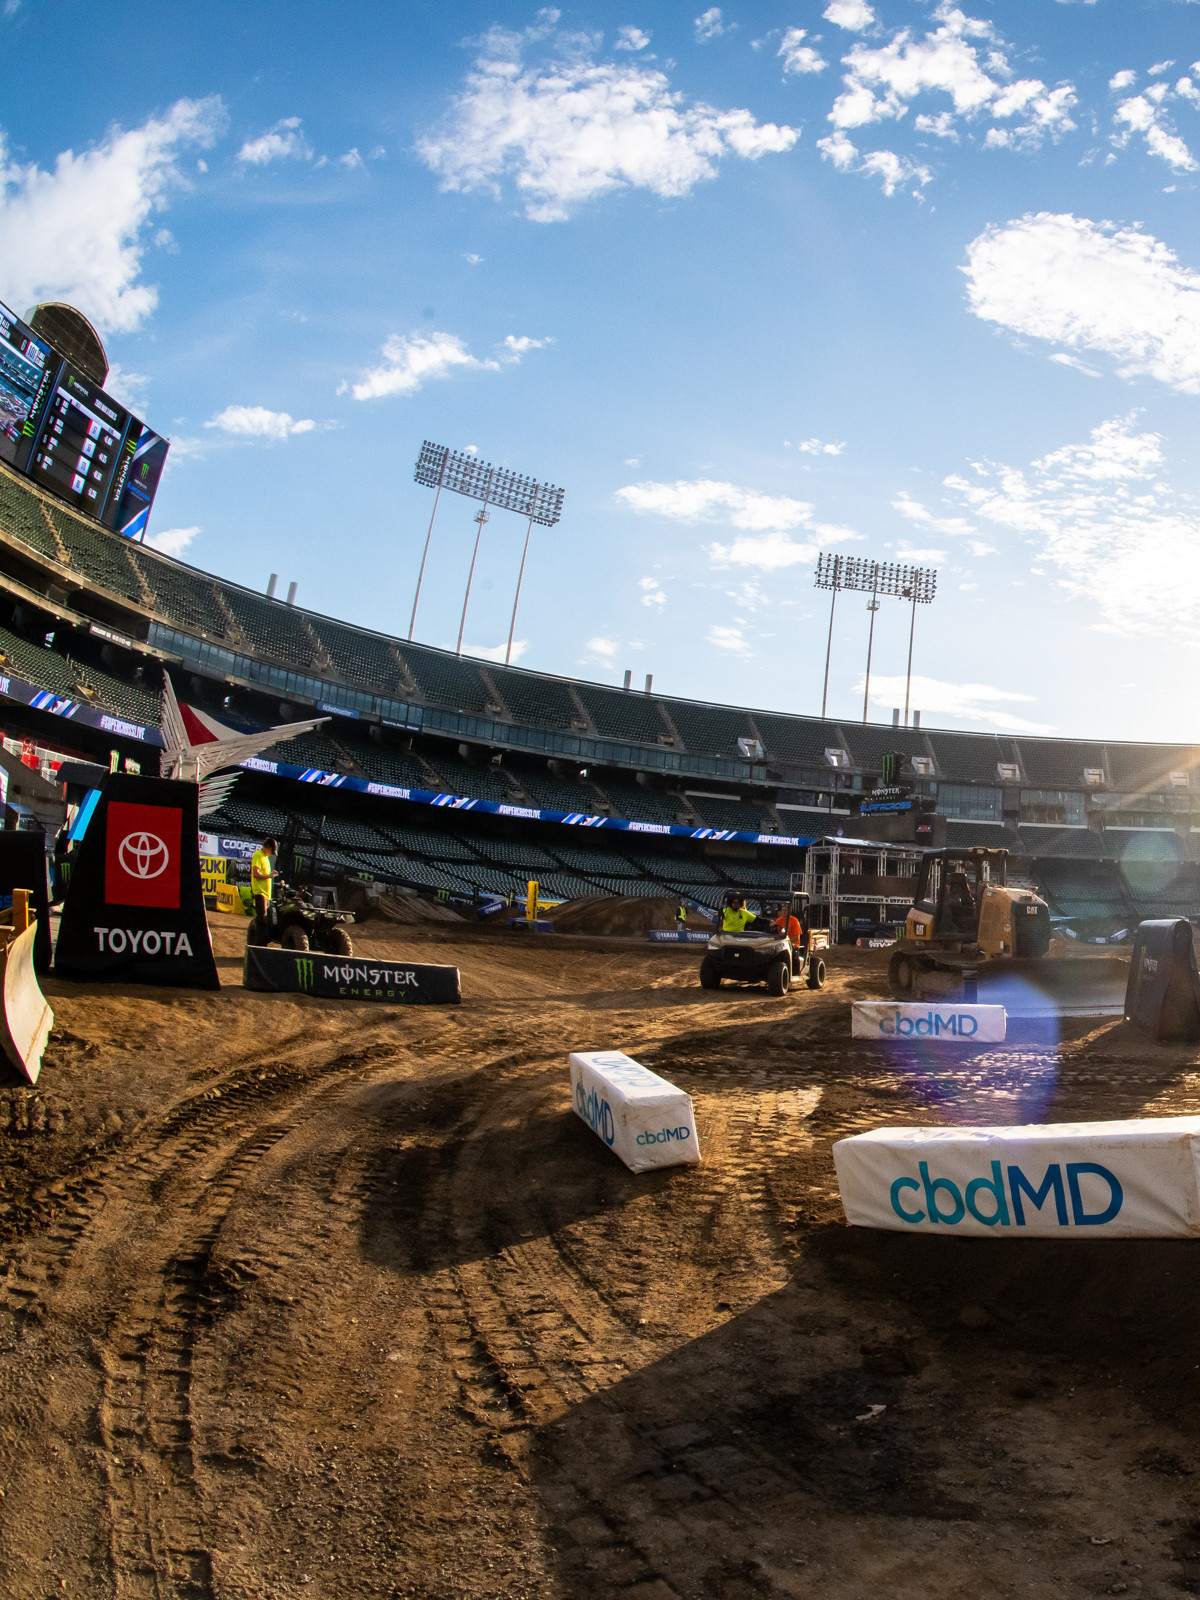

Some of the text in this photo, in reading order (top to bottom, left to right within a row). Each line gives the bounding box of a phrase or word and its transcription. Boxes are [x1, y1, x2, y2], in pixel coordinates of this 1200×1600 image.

[200, 858, 225, 874] ZUKI
[1026, 906, 1038, 915] CAT
[915, 924, 925, 936] CAT
[94, 927, 193, 957] TOYOTA
[324, 964, 419, 988] MONSTER
[339, 987, 406, 998] ENERGY
[879, 1011, 978, 1036] cbdMD
[636, 1126, 690, 1146] cbdMD
[890, 1159, 1124, 1227] cbdMD
